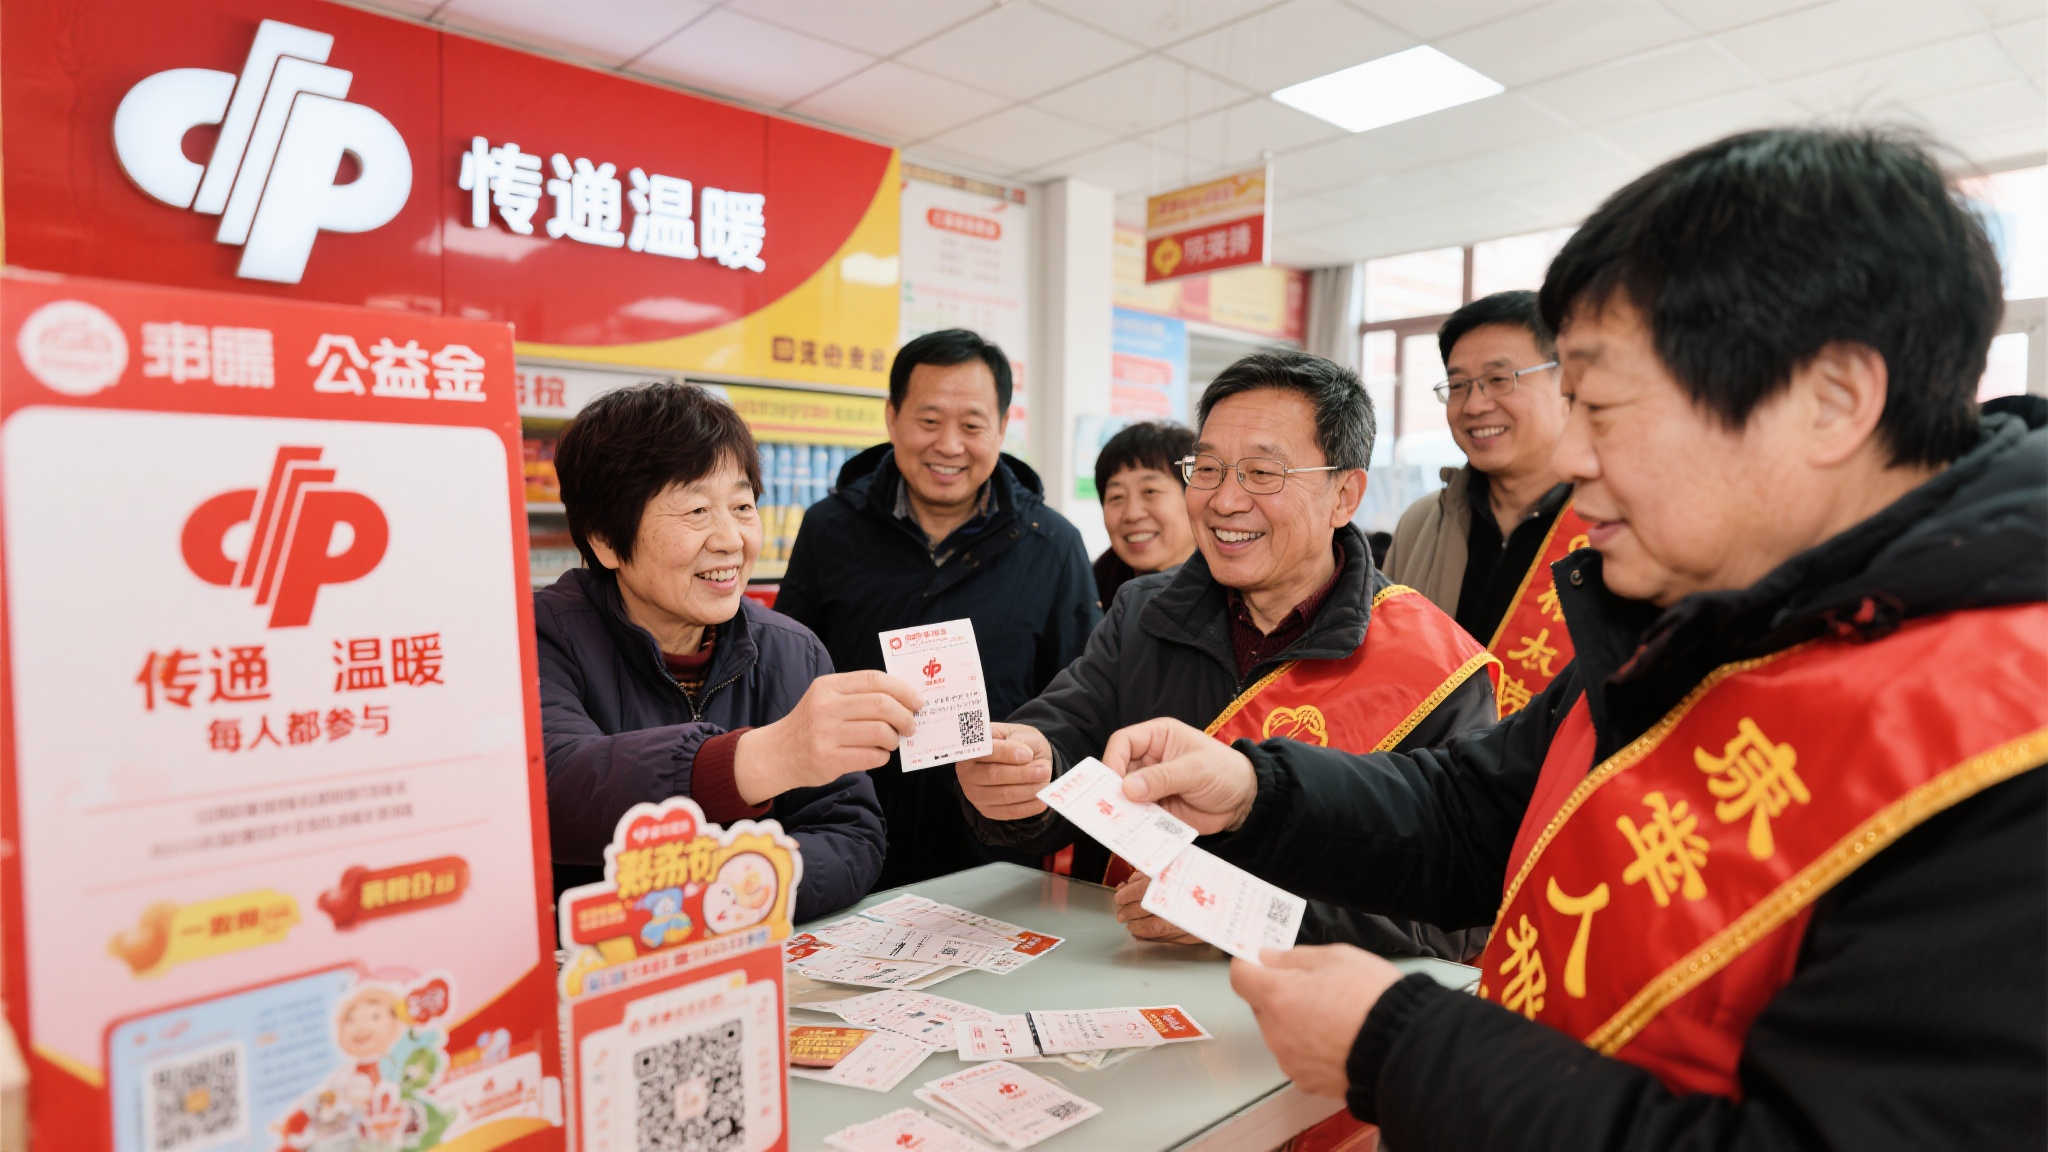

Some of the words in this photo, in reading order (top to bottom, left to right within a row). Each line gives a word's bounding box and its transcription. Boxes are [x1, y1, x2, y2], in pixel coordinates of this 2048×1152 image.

[307, 333, 487, 402] 公益金
[135, 645, 271, 712] 传通
[333, 633, 444, 692] 温暖
[207, 704, 390, 753] 每人都参与
